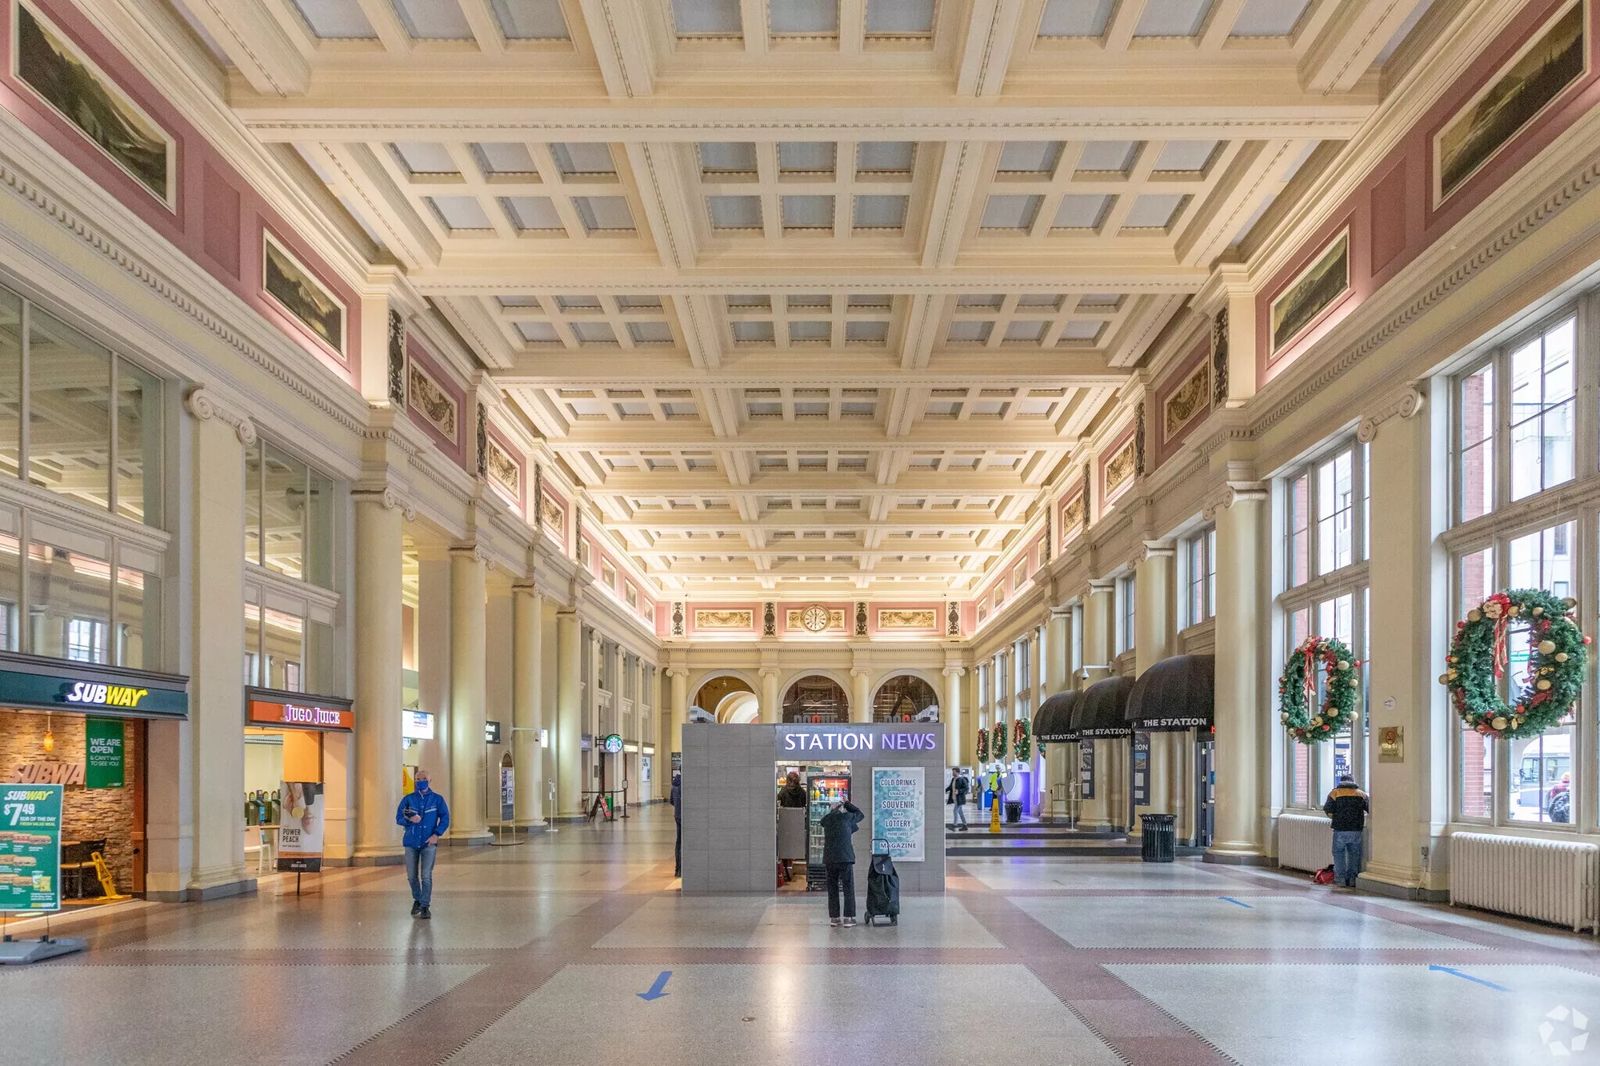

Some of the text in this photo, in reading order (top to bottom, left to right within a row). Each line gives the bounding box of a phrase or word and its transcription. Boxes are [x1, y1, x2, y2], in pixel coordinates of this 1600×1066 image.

[67, 682, 149, 707] SUBWAY
[284, 703, 341, 725] JUGO JUICE
[1142, 717, 1207, 727] THE STATION
[1082, 727, 1131, 736] THE STATION
[90, 738, 121, 747] WE ARE
[784, 733, 936, 750] STATION NEWS
[89, 745, 114, 754] OPEN
[7, 762, 87, 785] SUBWA
[4, 790, 54, 801] SUBWAY
[882, 800, 915, 809] SOUVENIR
[885, 819, 911, 827] LOTTERY
[282, 828, 301, 836] POWER
[282, 835, 299, 843] PEACH
[880, 842, 917, 850] MAGAZINE
